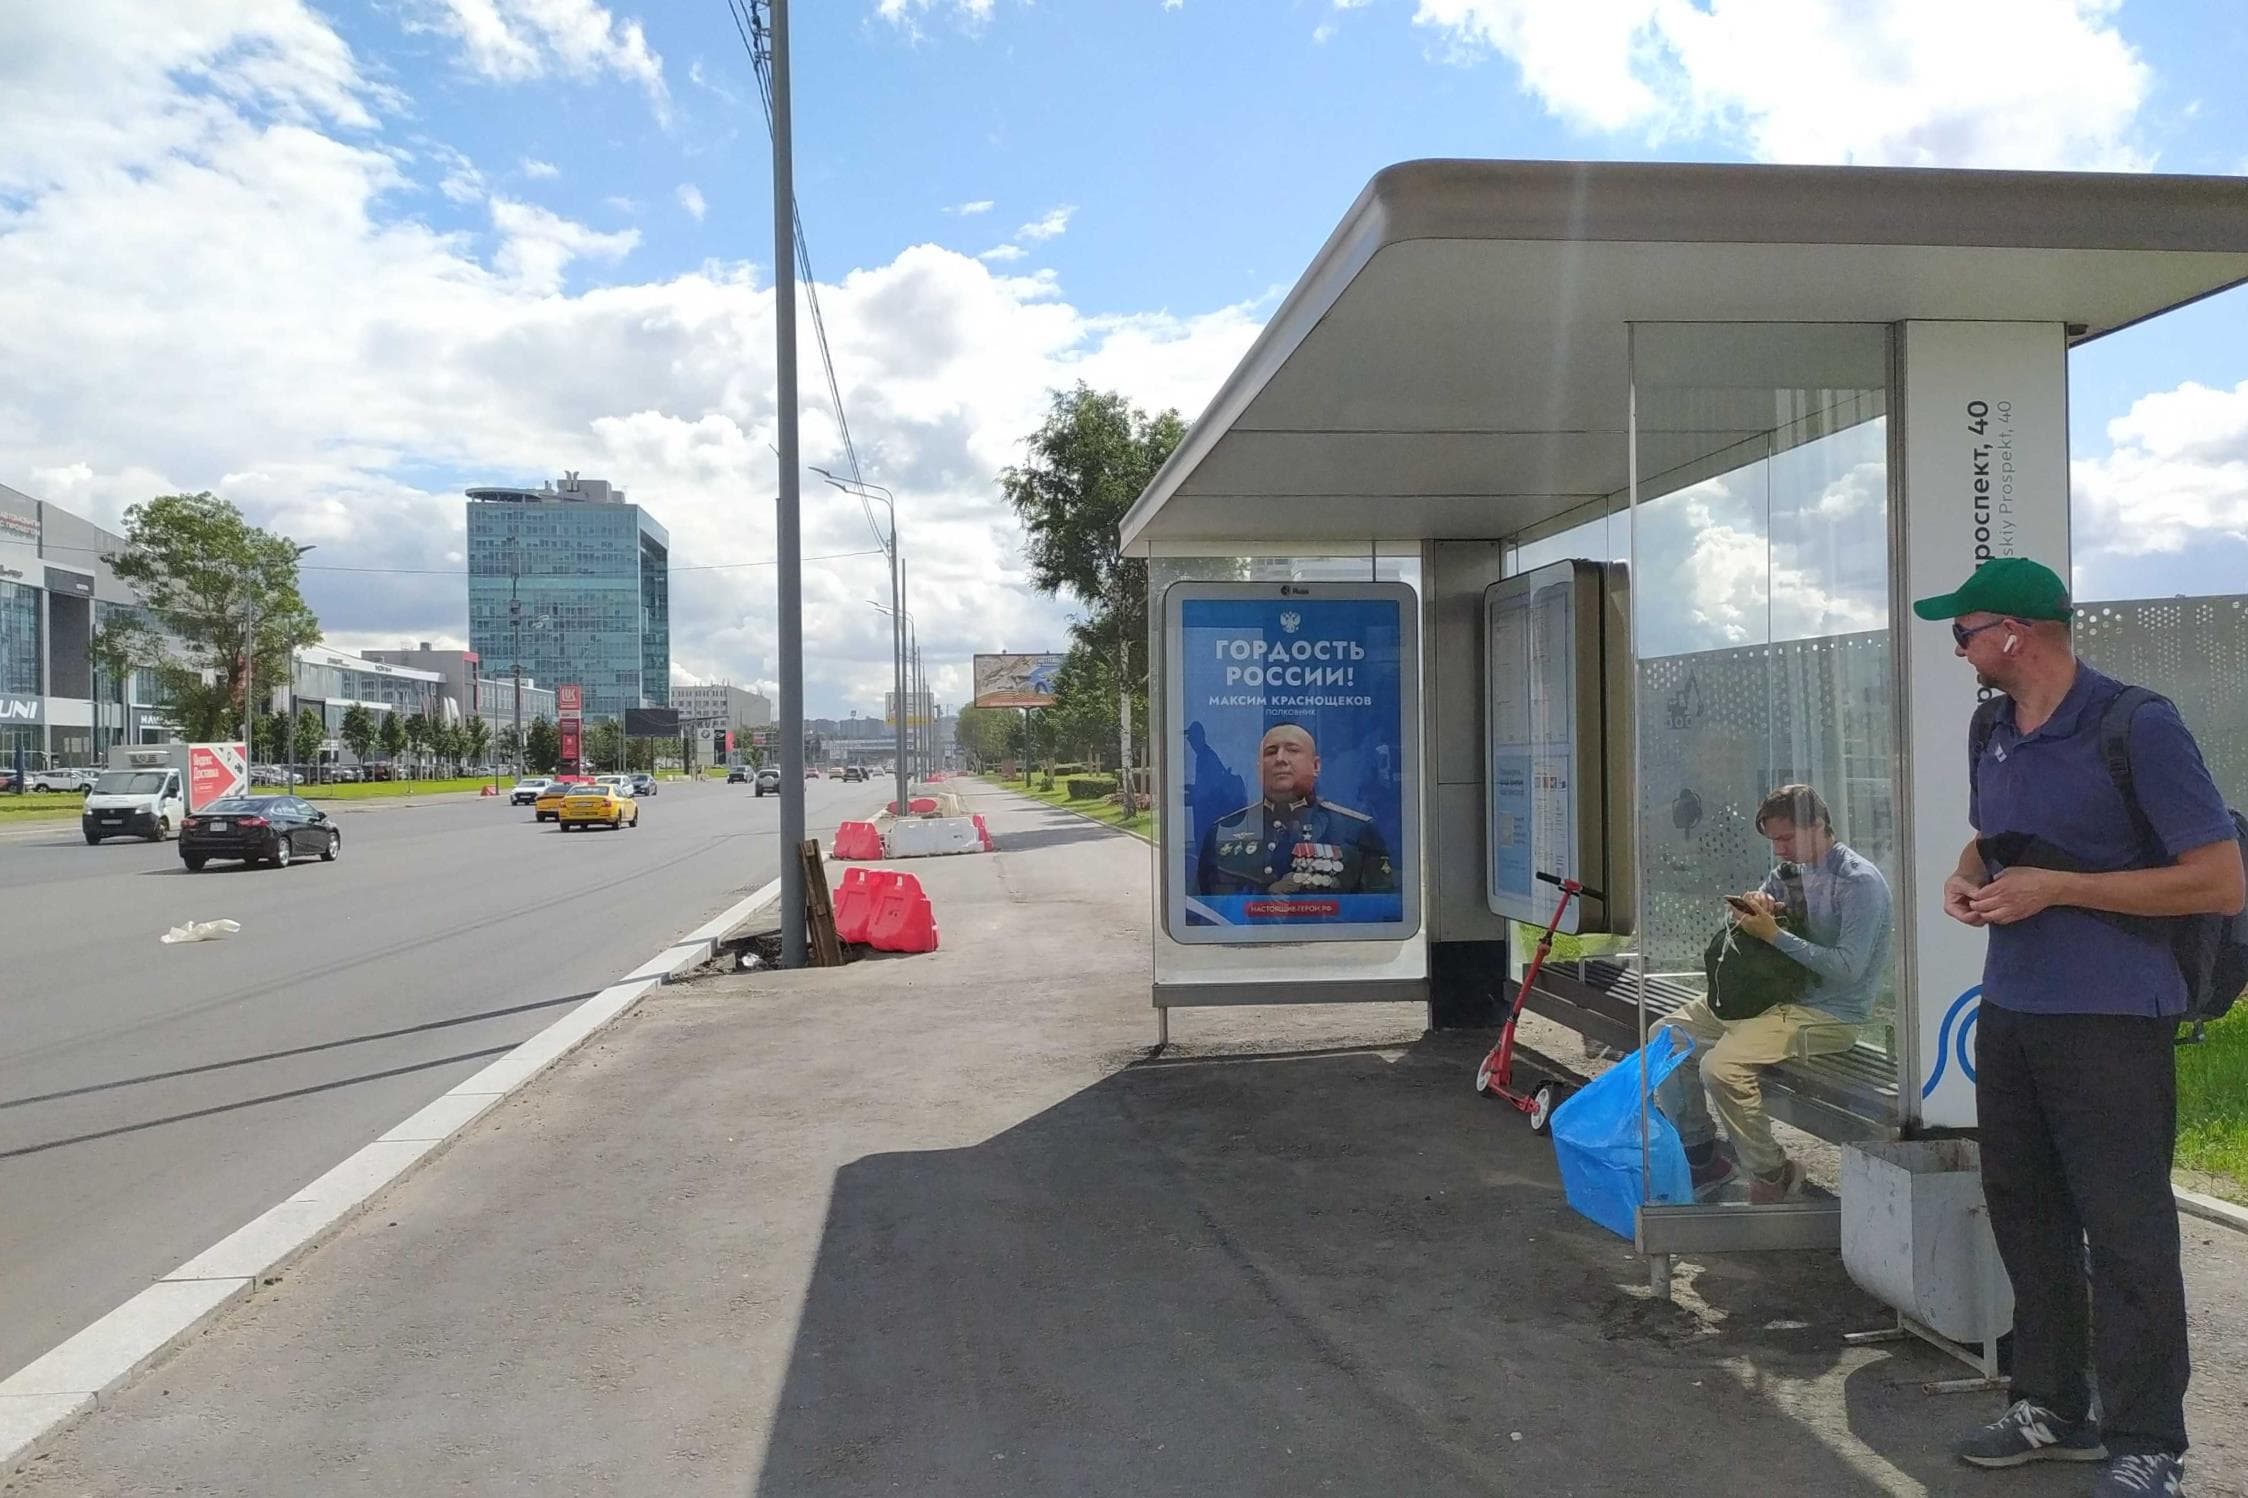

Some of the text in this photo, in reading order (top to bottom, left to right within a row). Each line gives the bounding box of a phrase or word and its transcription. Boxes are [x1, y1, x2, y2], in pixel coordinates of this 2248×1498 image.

[1966, 400, 1989, 436] 40
[1996, 400, 2016, 557] skiy Prospekt, 40
[1215, 640, 1365, 662] ГОРДОСТЬ
[1226, 666, 1355, 687] РОССИИ!
[1209, 695, 1372, 707] МАКСИМ КРАСНОЩЕКОВ
